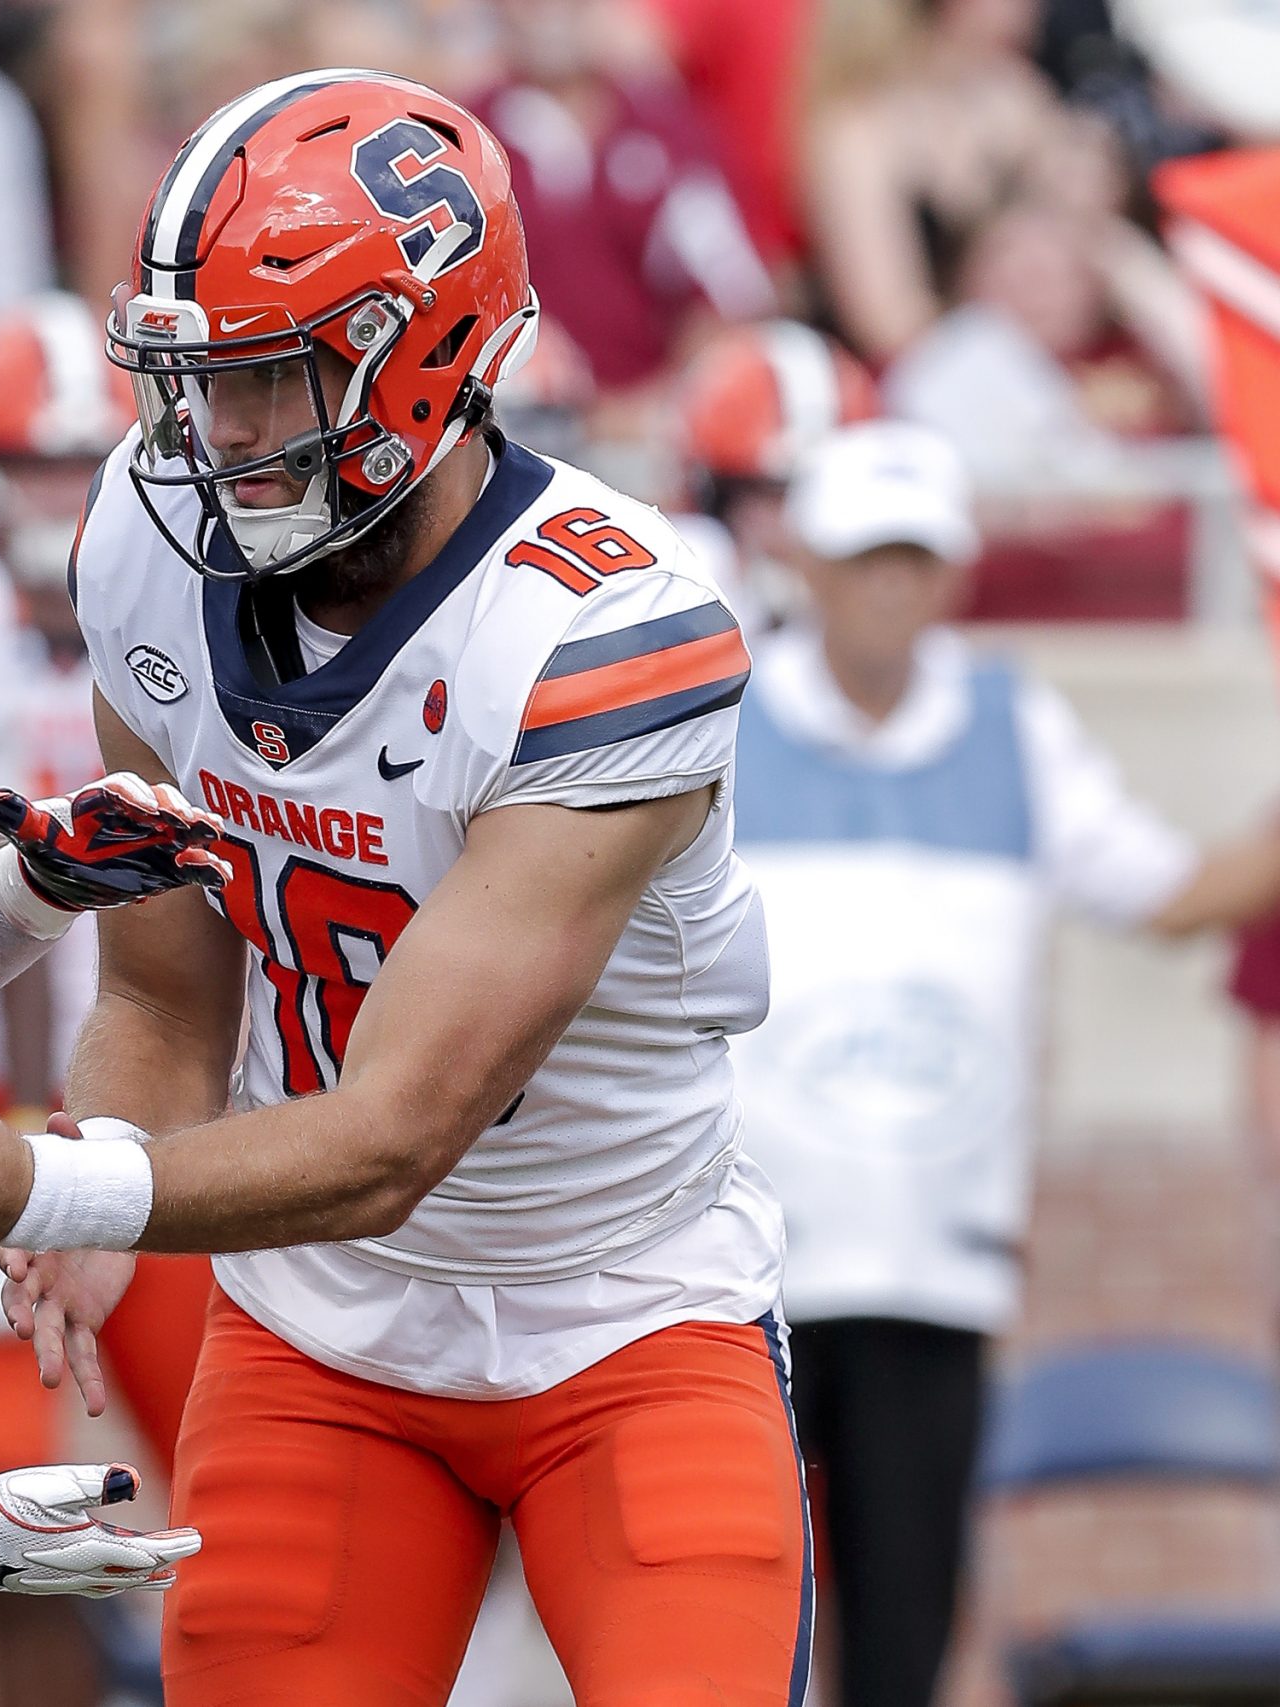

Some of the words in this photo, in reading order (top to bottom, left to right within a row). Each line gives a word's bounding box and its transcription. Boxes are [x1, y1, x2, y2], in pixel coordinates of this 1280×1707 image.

[350, 118, 487, 280] S
[505, 507, 658, 598] 16
[135, 657, 182, 689] ACC
[251, 720, 290, 763] S
[198, 768, 389, 866] ORANGE
